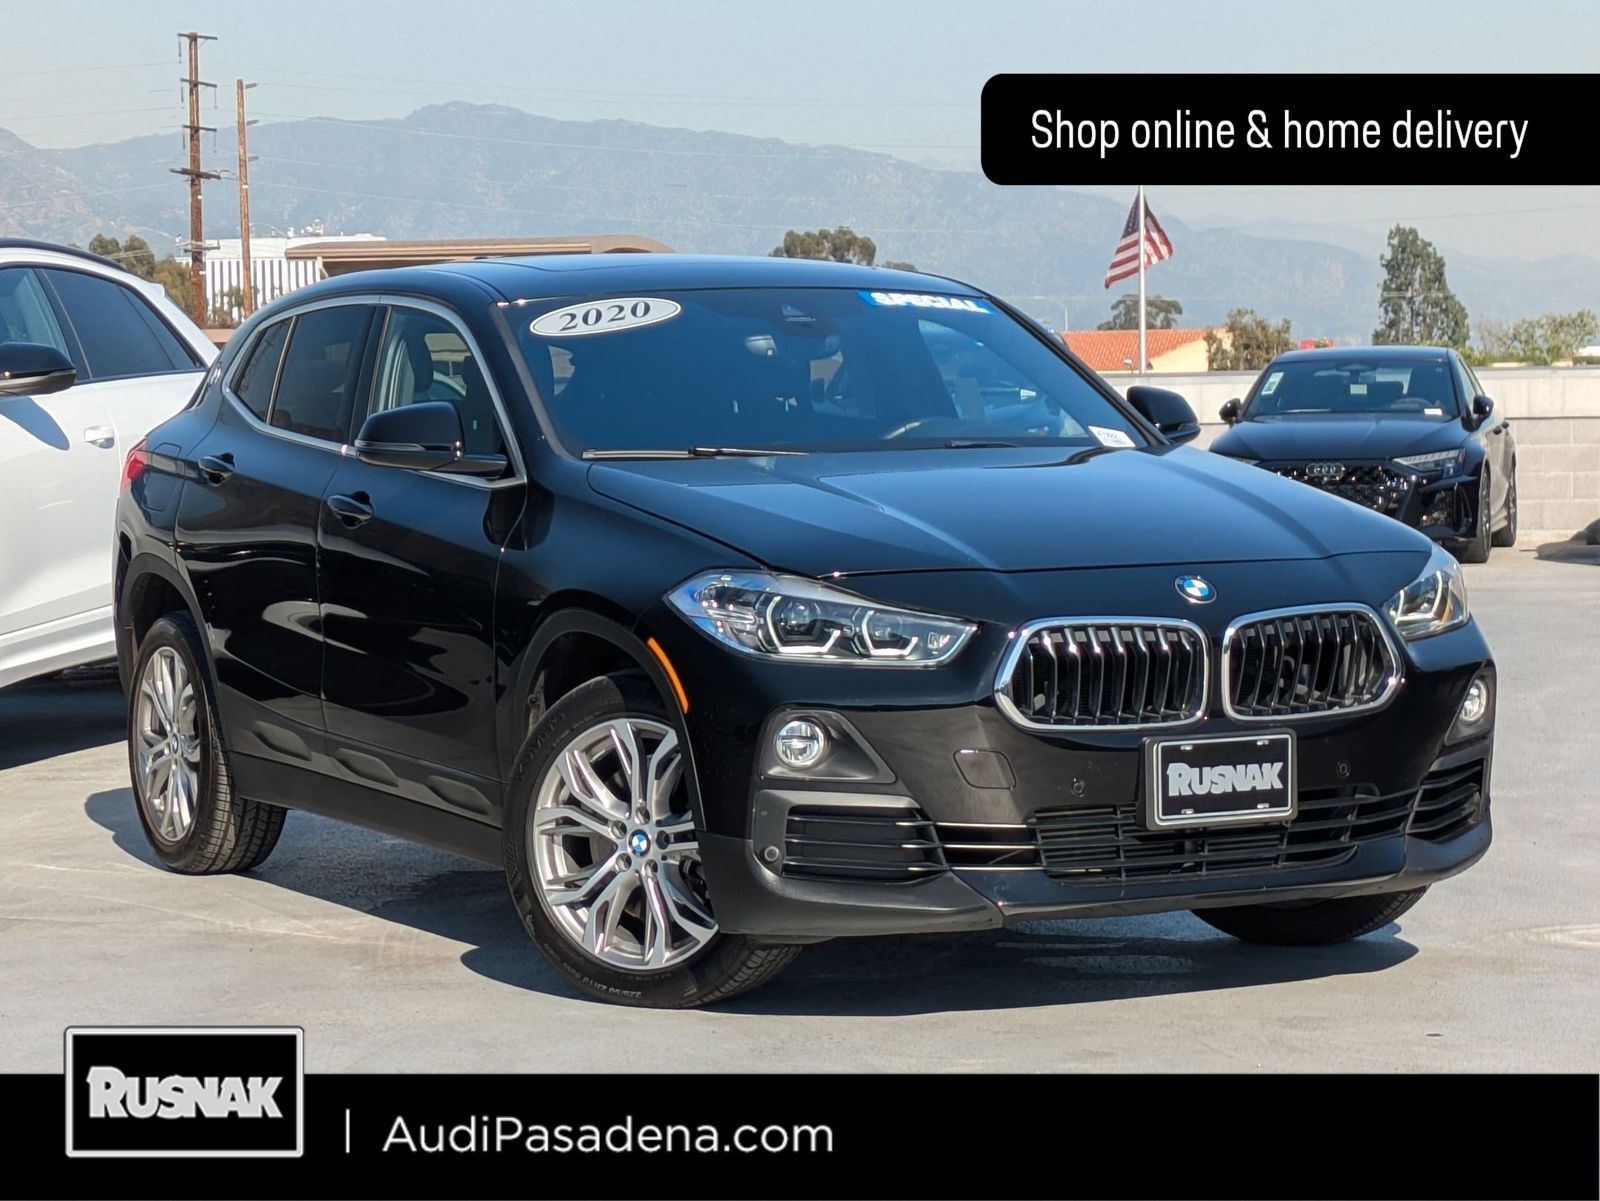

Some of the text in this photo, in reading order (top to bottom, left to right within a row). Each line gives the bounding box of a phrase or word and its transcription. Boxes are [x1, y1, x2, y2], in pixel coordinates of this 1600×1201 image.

[559, 300, 650, 332] 2020
[870, 292, 991, 314] SPECIAL
[1166, 762, 1283, 797] RUSNAK
